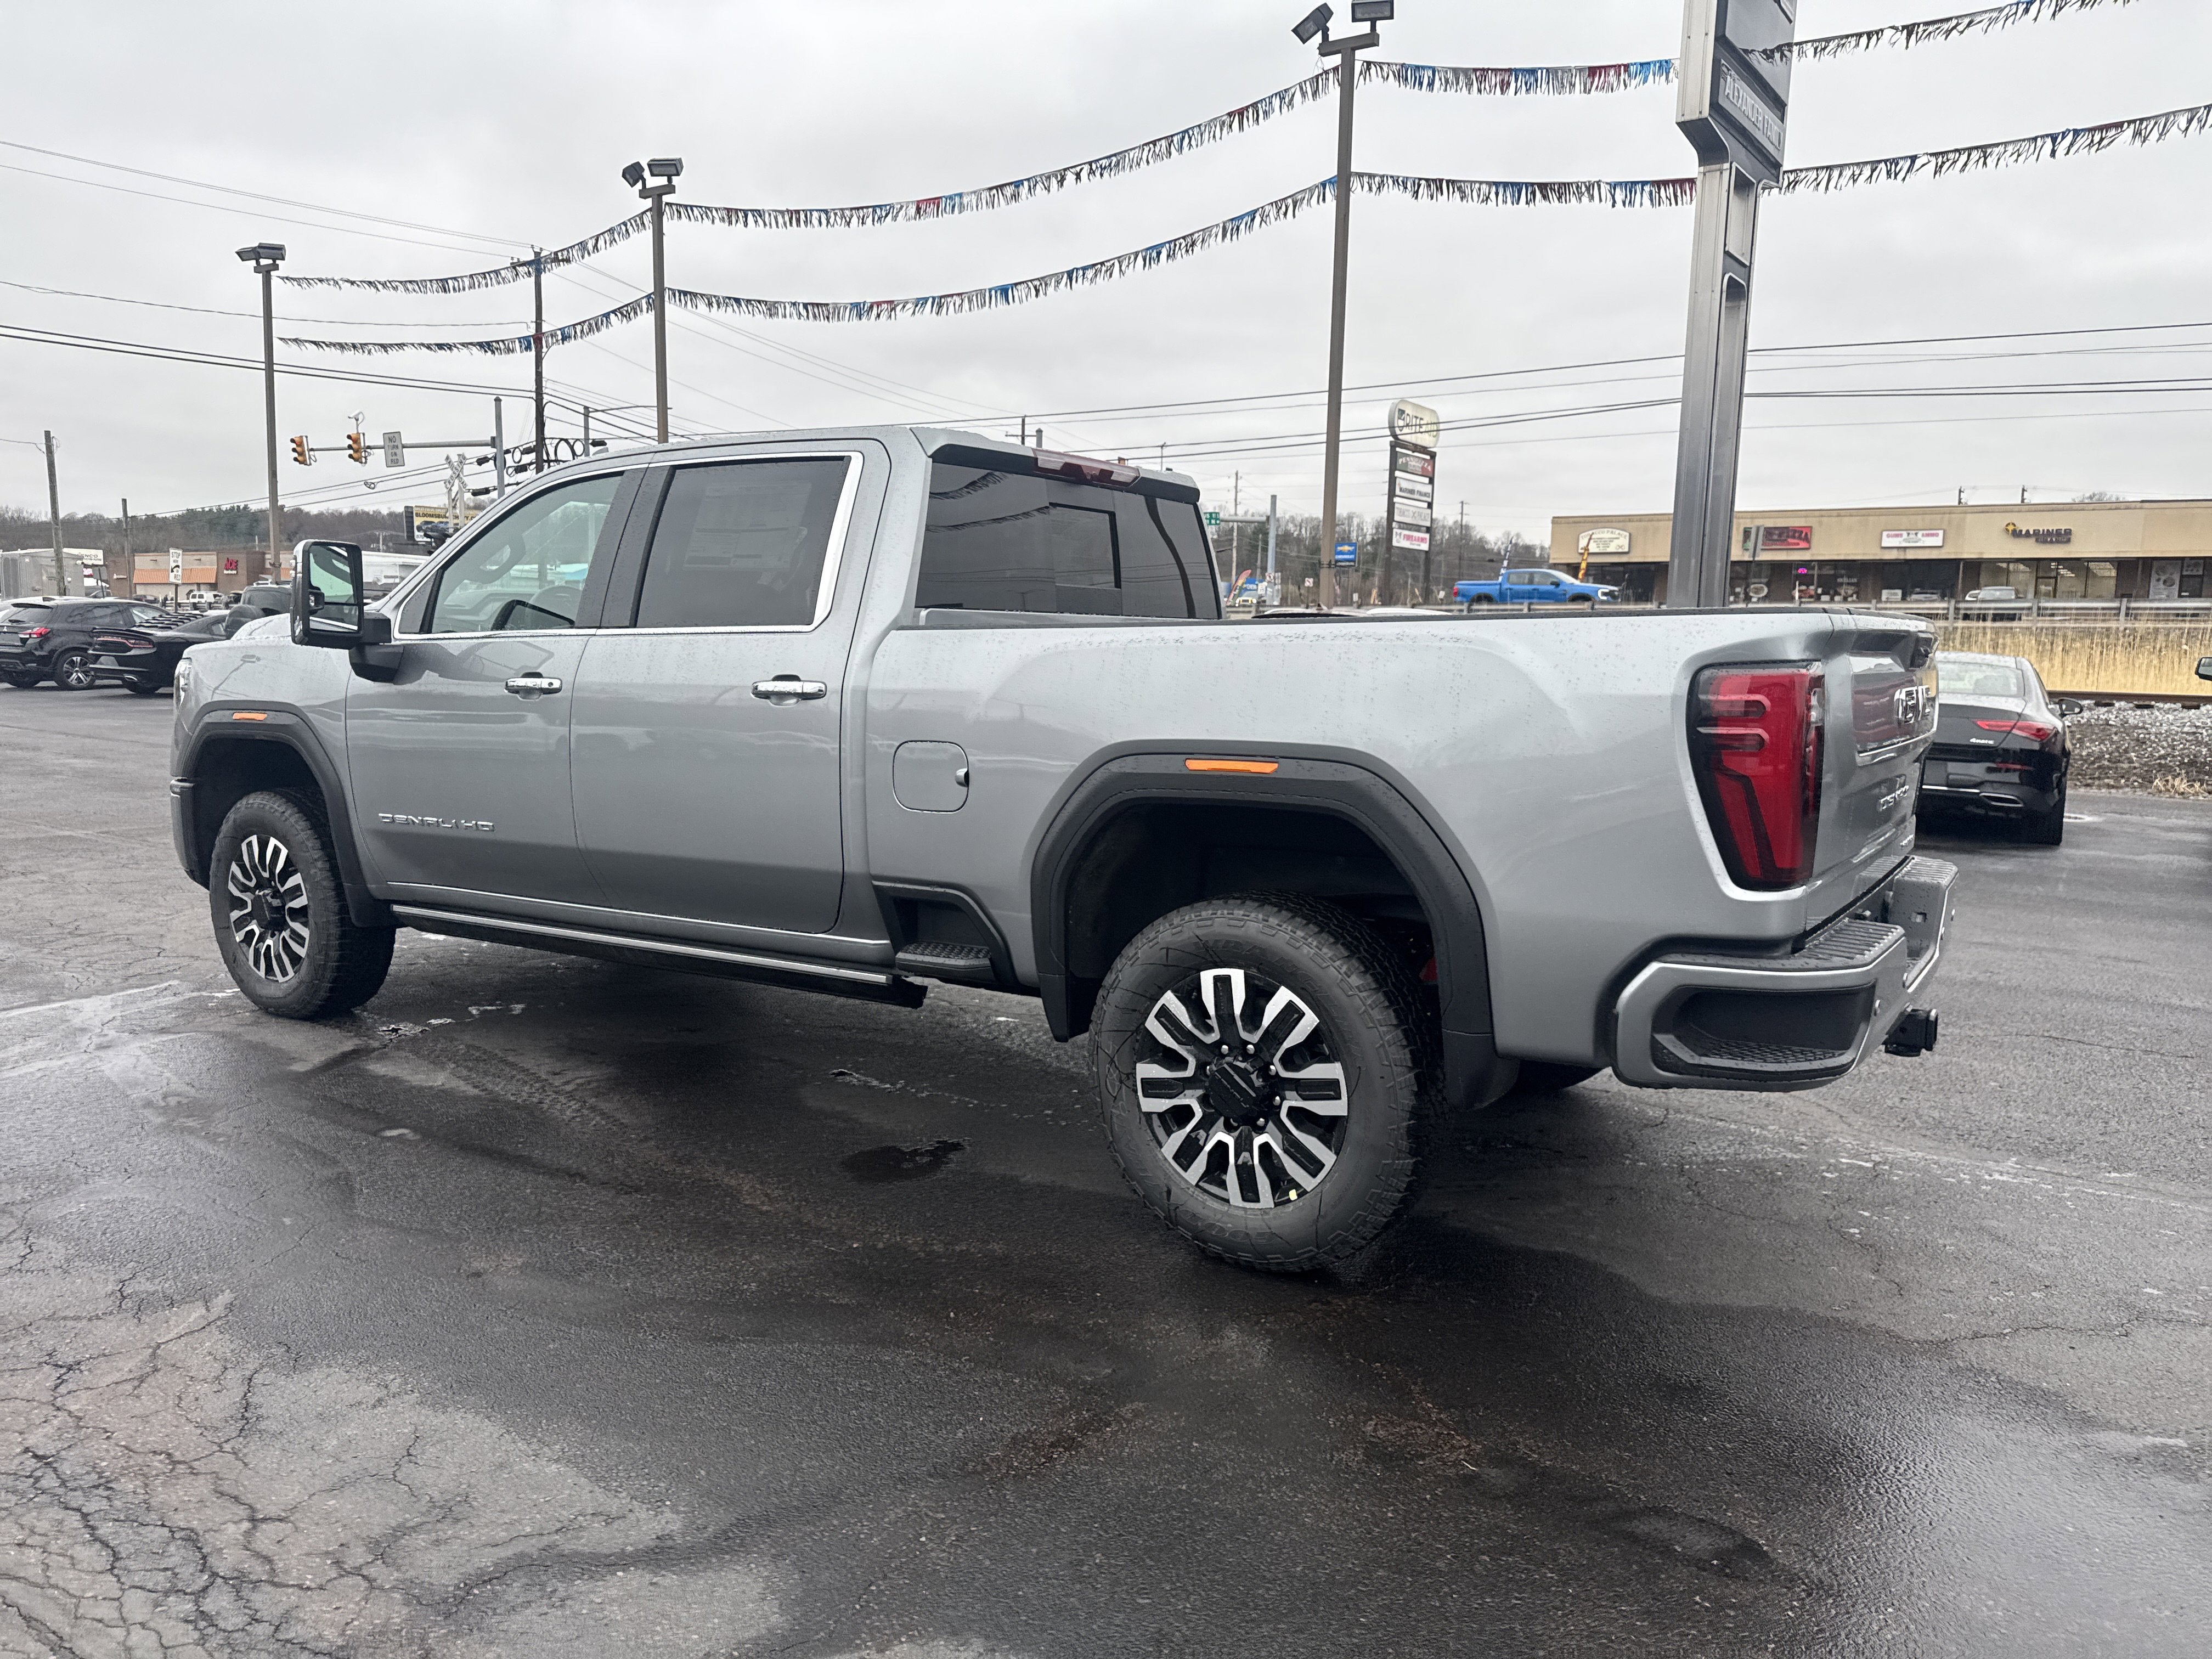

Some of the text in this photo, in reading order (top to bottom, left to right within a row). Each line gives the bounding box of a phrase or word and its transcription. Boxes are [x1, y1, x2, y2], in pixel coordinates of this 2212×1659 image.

[1725, 75, 1763, 131] ALEXANDER
[1406, 413, 1424, 434] RITE
[388, 435, 396, 443] NO
[2012, 528, 2072, 538] MARINER
